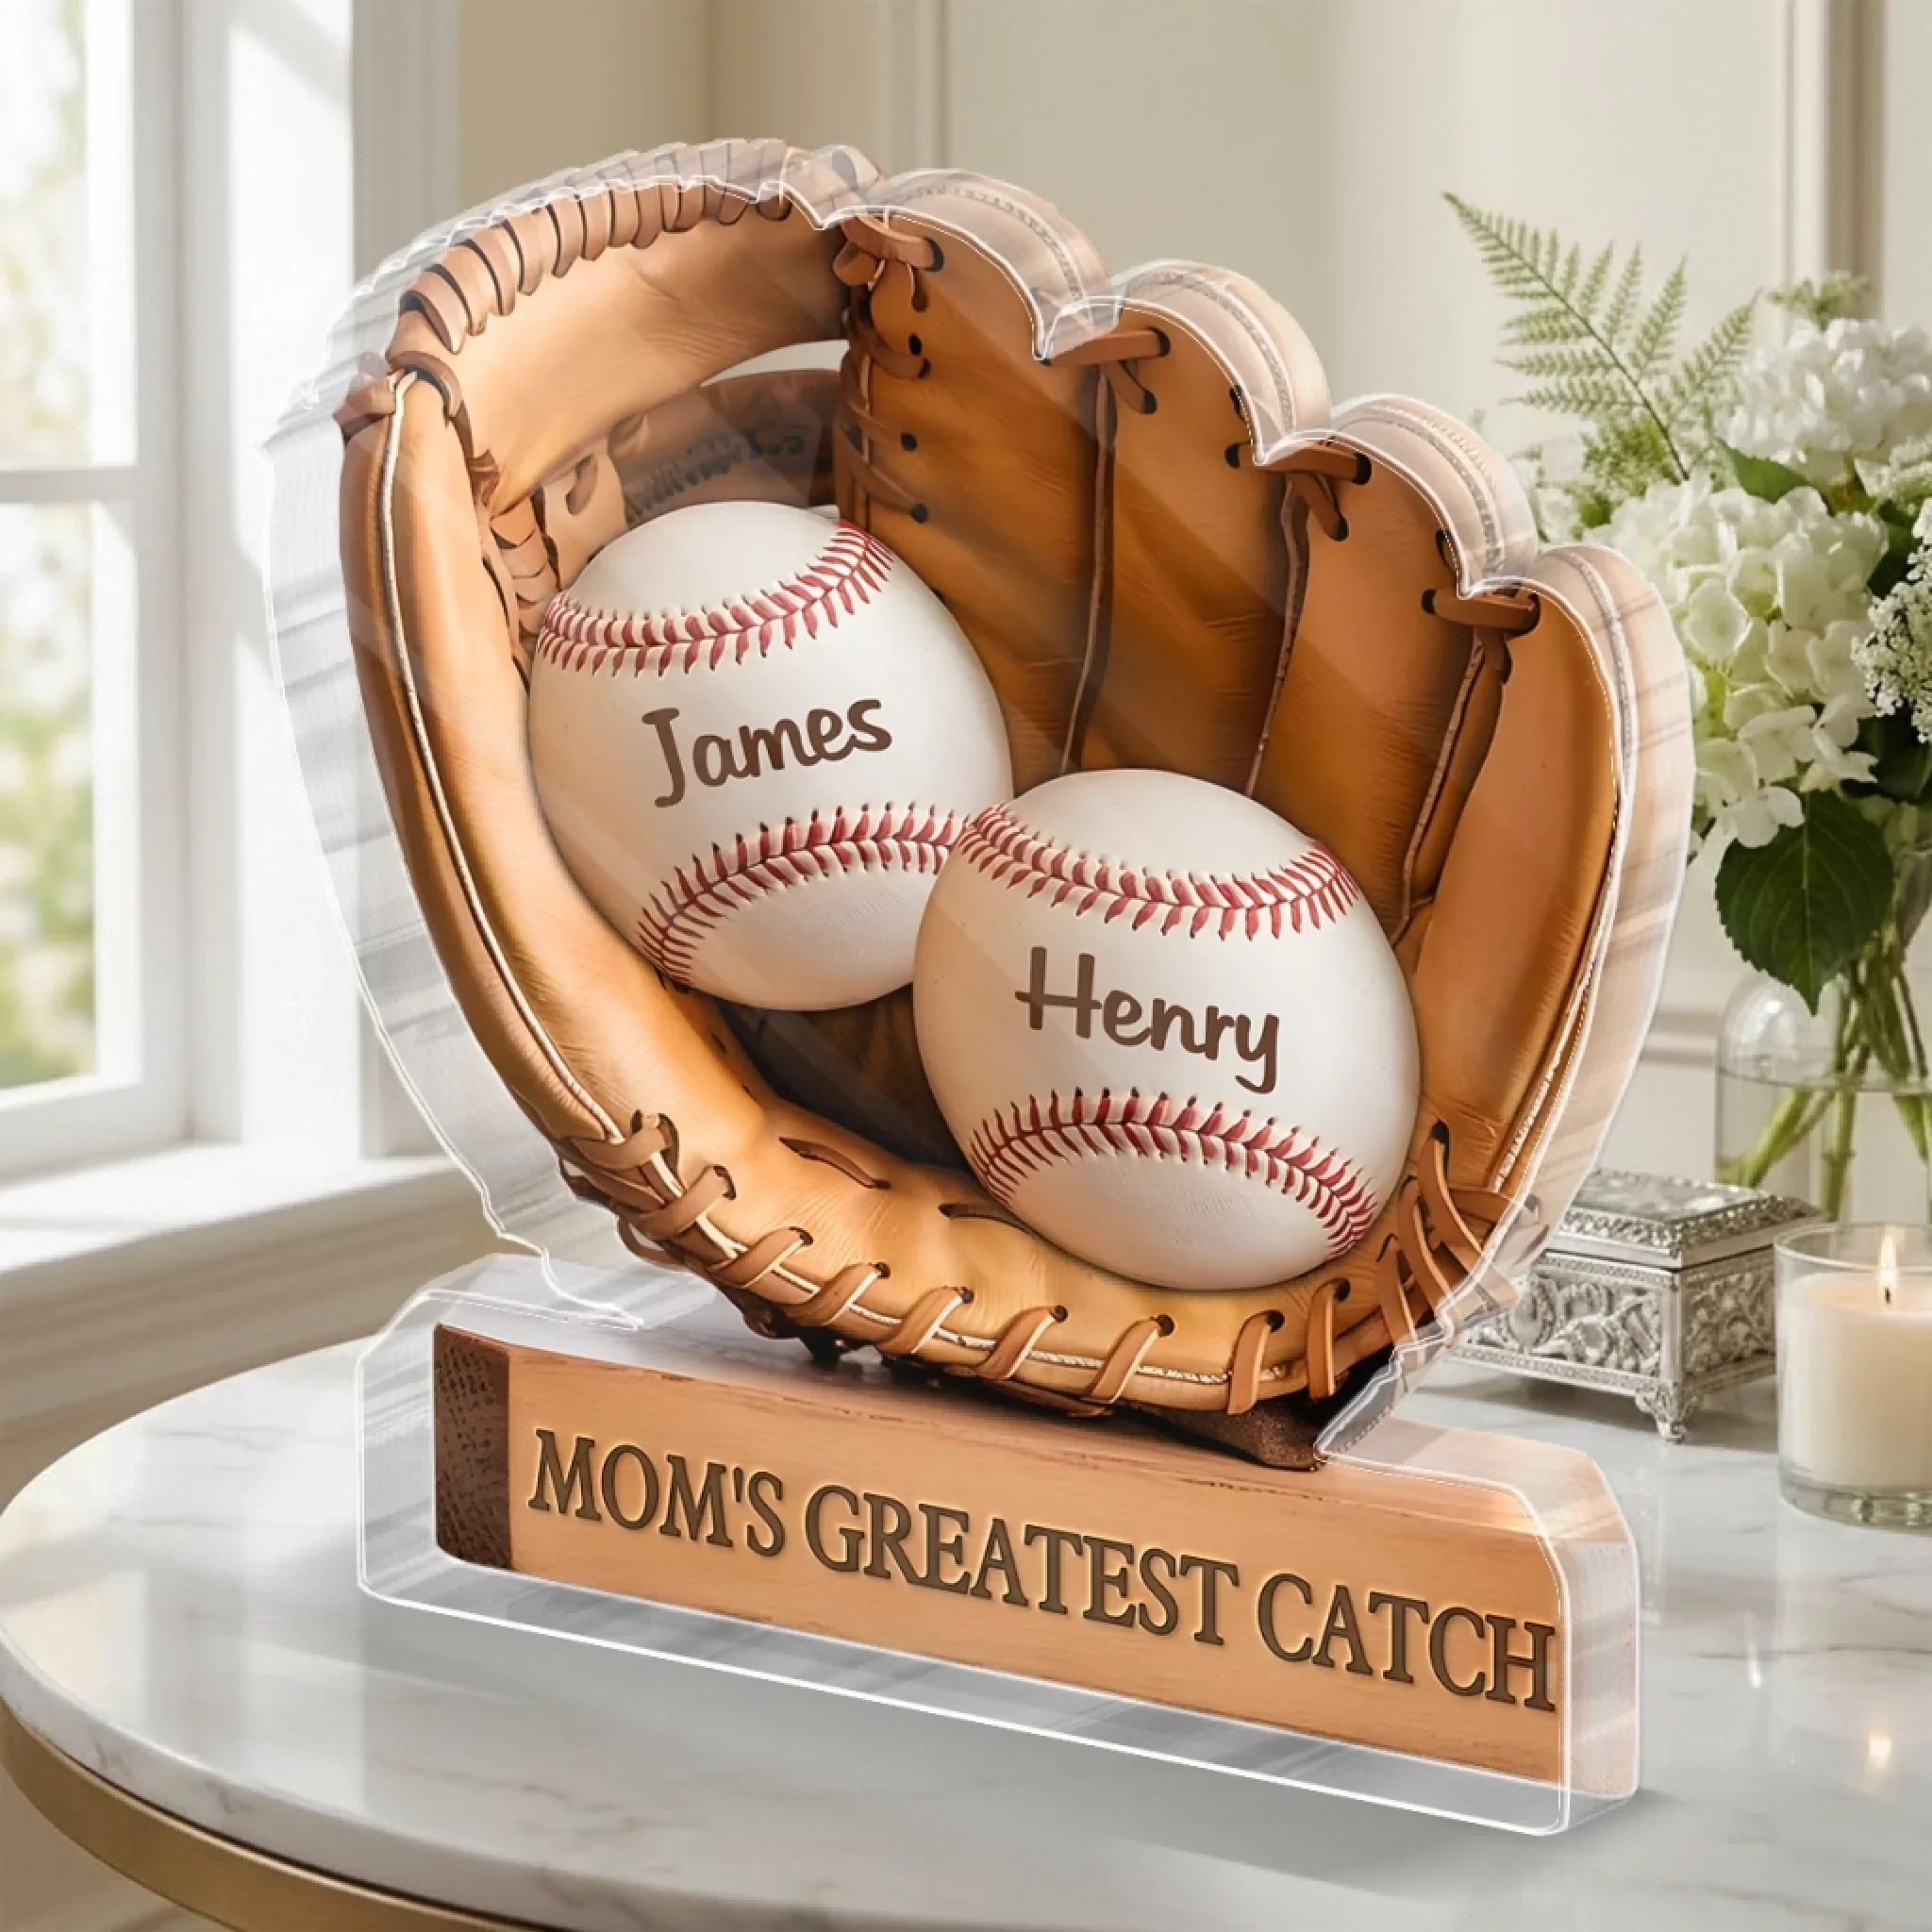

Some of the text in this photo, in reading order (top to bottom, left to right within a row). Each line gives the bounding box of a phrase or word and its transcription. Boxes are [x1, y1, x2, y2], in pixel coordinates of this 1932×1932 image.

[642, 698, 892, 808] James
[1016, 946, 1279, 1093] Henry
[527, 1429, 1556, 1712] MOM'S GREATEST CATCH
